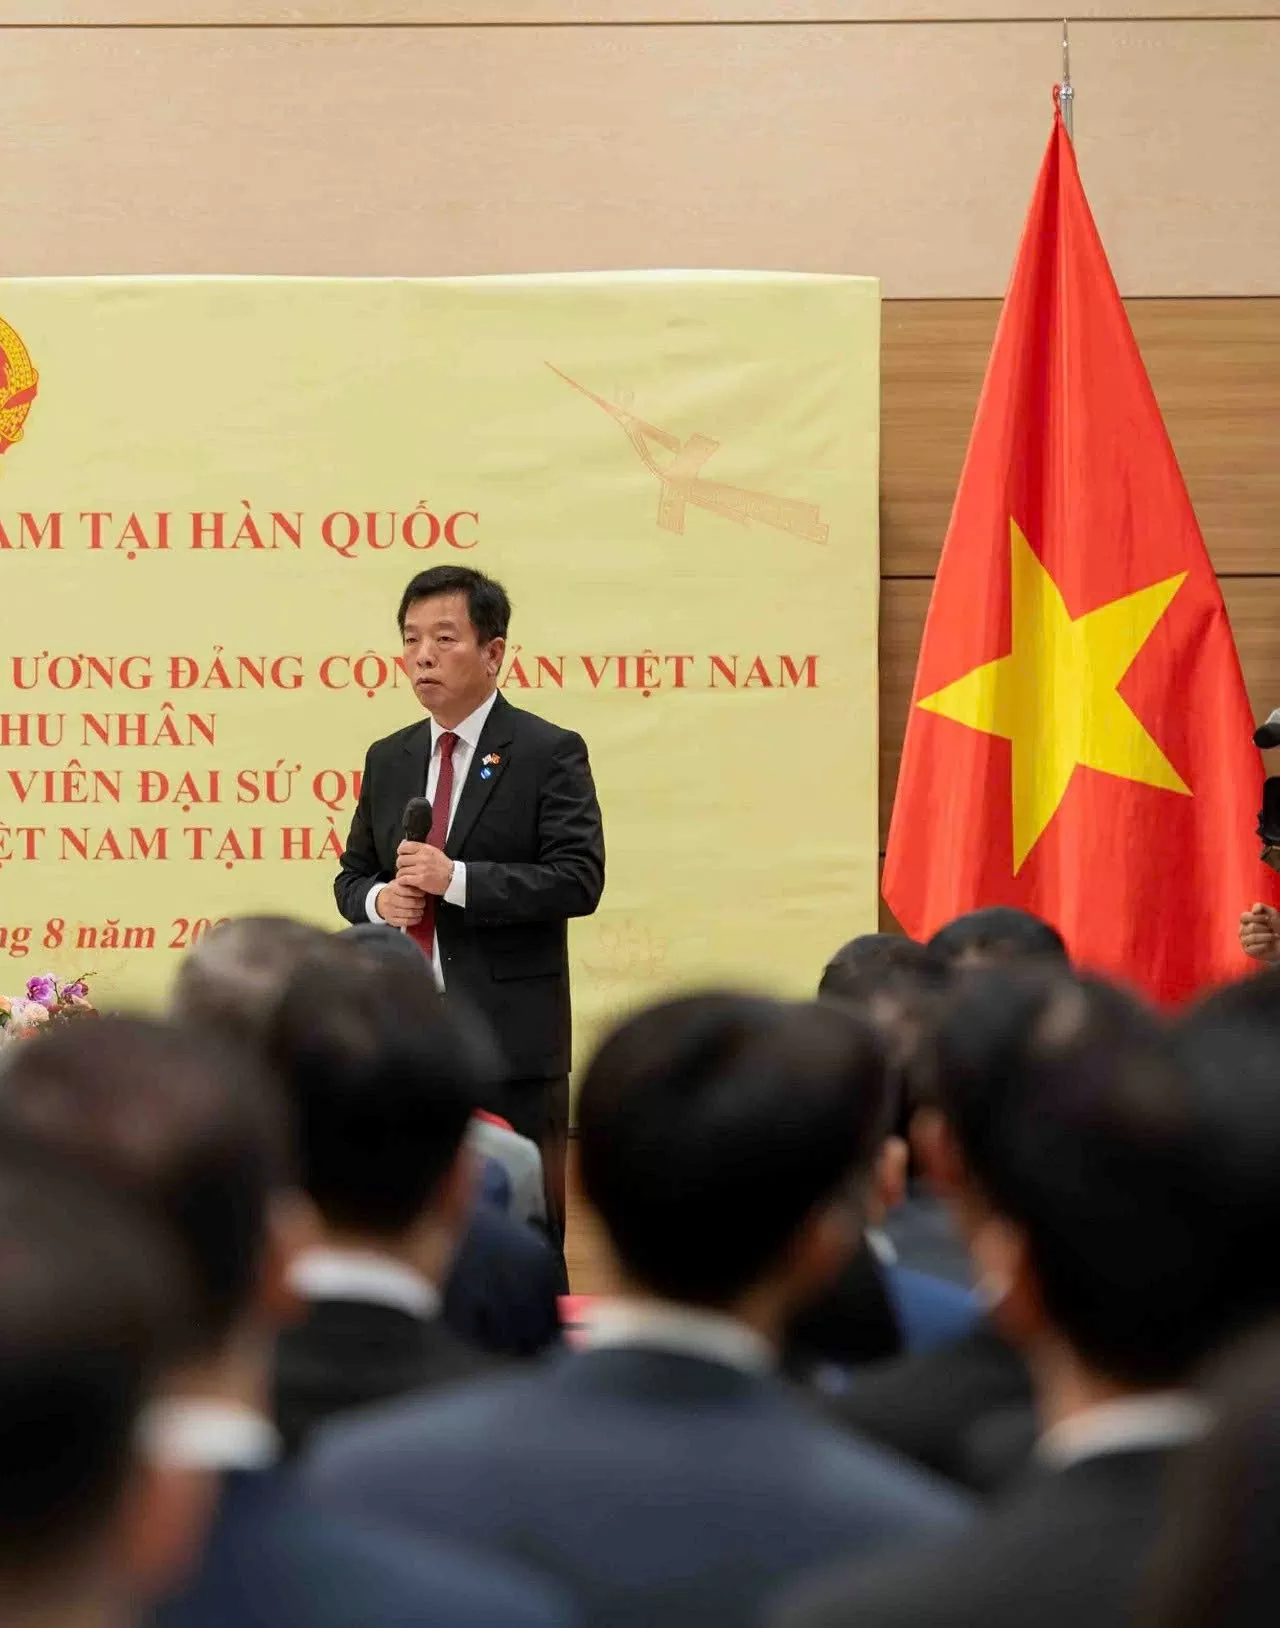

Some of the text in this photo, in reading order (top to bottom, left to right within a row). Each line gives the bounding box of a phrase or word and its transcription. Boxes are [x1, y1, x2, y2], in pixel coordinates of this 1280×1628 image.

[78, 511, 173, 560] TẠI
[187, 500, 304, 551] HÀN
[320, 500, 481, 559] QUỐC
[10, 649, 154, 690] ƯƠNG
[166, 644, 306, 691] ĐẢNG
[318, 649, 410, 698] CỘN
[501, 644, 566, 690] ẢN
[579, 649, 695, 697] VIỆT
[707, 655, 819, 689] NAM
[79, 702, 217, 748] NHÂN
[7, 759, 123, 804] VIÊN
[136, 769, 222, 812] ĐẠI
[236, 759, 303, 804] SỨ
[58, 826, 170, 861] NAM
[182, 826, 266, 870] TẠI
[280, 816, 345, 860] HÀ
[41, 917, 66, 949] 8
[75, 918, 157, 950] năm
